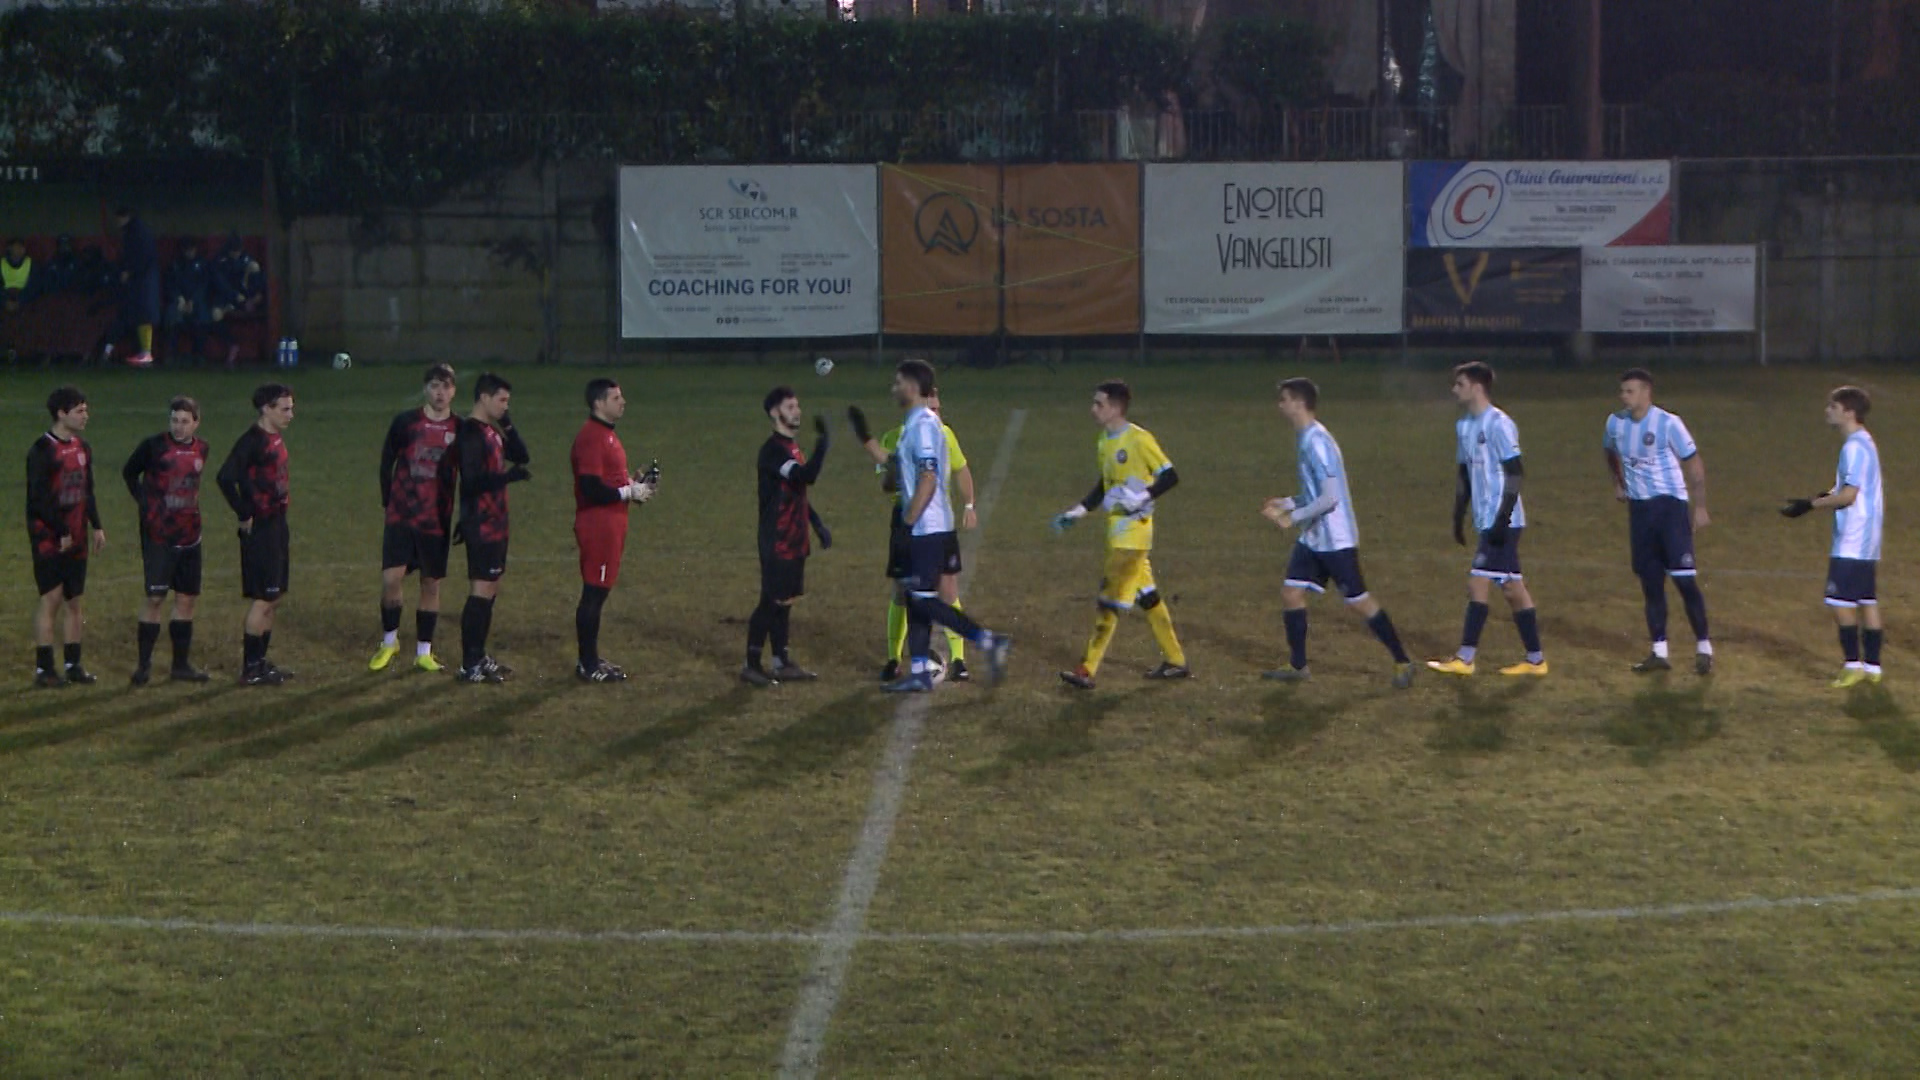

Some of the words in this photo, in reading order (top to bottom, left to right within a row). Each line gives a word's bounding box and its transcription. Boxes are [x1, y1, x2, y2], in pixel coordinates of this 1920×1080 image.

[0, 166, 38, 180] ITI
[698, 207, 723, 220] SCR
[1224, 183, 1324, 224] ENOTECA
[1453, 183, 1495, 225] C
[1027, 206, 1108, 228] SOSTA
[1216, 233, 1331, 274] VANGELISTI
[648, 278, 754, 296] COACHING
[760, 278, 799, 295] FOR
[805, 278, 852, 295] YOU!
[600, 563, 607, 583] 1
